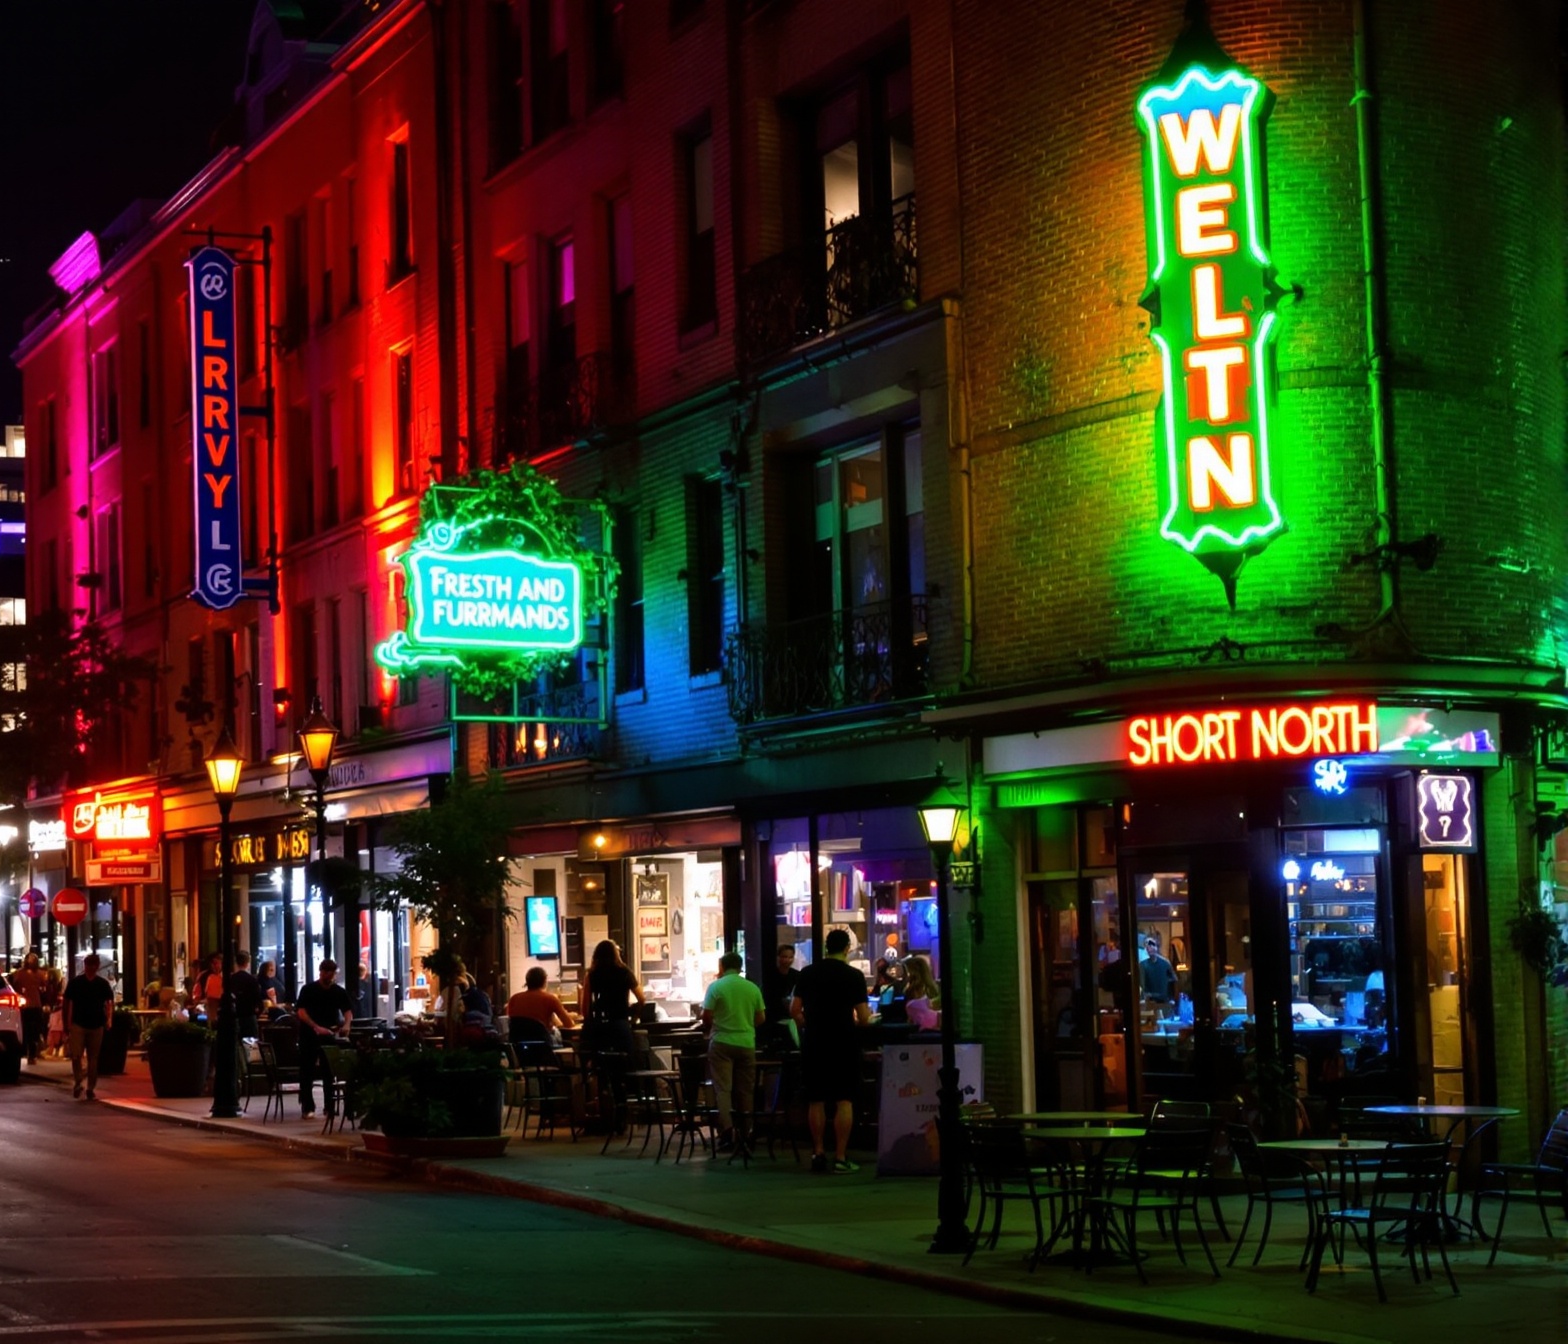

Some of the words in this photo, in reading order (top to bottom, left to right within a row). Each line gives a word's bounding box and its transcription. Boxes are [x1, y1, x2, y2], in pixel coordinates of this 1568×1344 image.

[1159, 104, 1257, 512] WELTN
[203, 311, 231, 551] LRRVYL
[430, 566, 512, 600] FRESTH
[517, 577, 565, 602] AND
[433, 599, 570, 630] FURRMANDS
[1129, 711, 1240, 765] SHORT
[1251, 704, 1378, 758] NORTH
